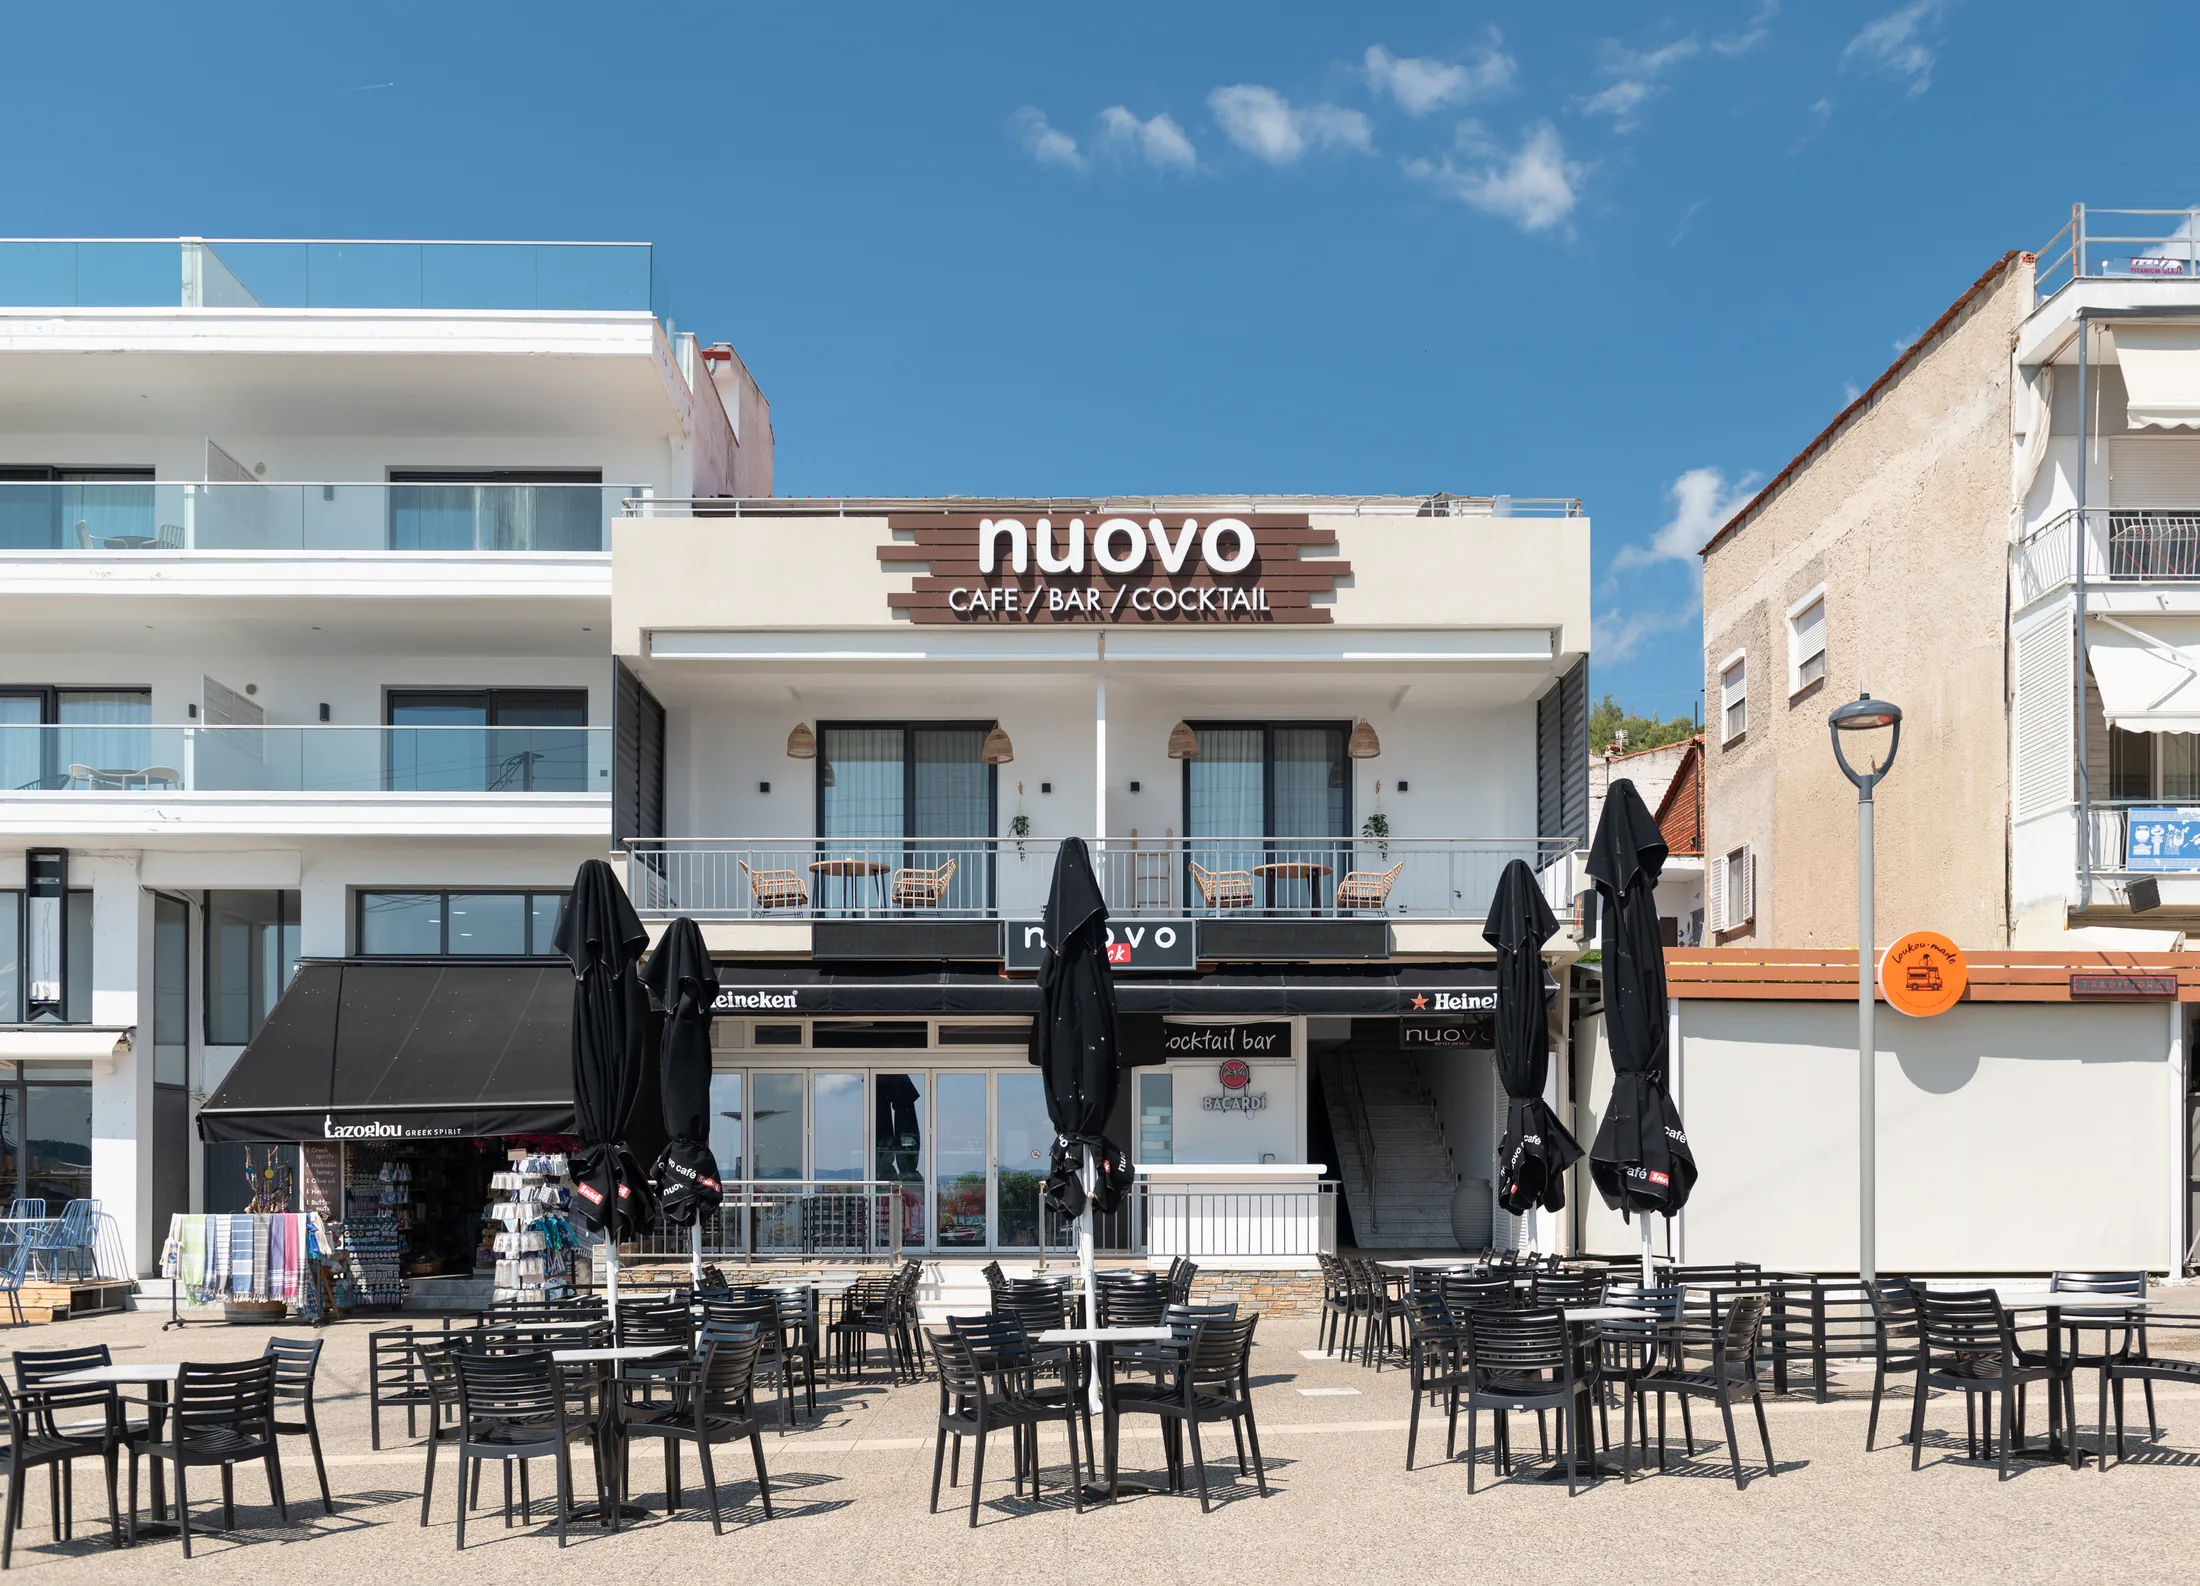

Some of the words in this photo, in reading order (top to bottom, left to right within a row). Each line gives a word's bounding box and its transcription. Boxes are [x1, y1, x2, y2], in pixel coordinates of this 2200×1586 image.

[978, 517, 1256, 575] nuovo
[948, 587, 1018, 612] CAFE
[1050, 587, 1102, 612] BAR
[1132, 587, 1270, 612] COCKTAIL
[1024, 926, 1177, 949] nvo
[2081, 980, 2172, 989] TRADITIONAL
[1434, 993, 1497, 1010] Heine
[1164, 1027, 1235, 1050] ocktail
[1243, 1030, 1276, 1050] bar
[405, 1129, 432, 1137] GREEK
[434, 1128, 461, 1136] SPIRIT
[675, 1164, 697, 1180] café
[1626, 1166, 1647, 1179] afé
[1651, 1172, 1669, 1184] Sna
[579, 1185, 602, 1203] Snack
